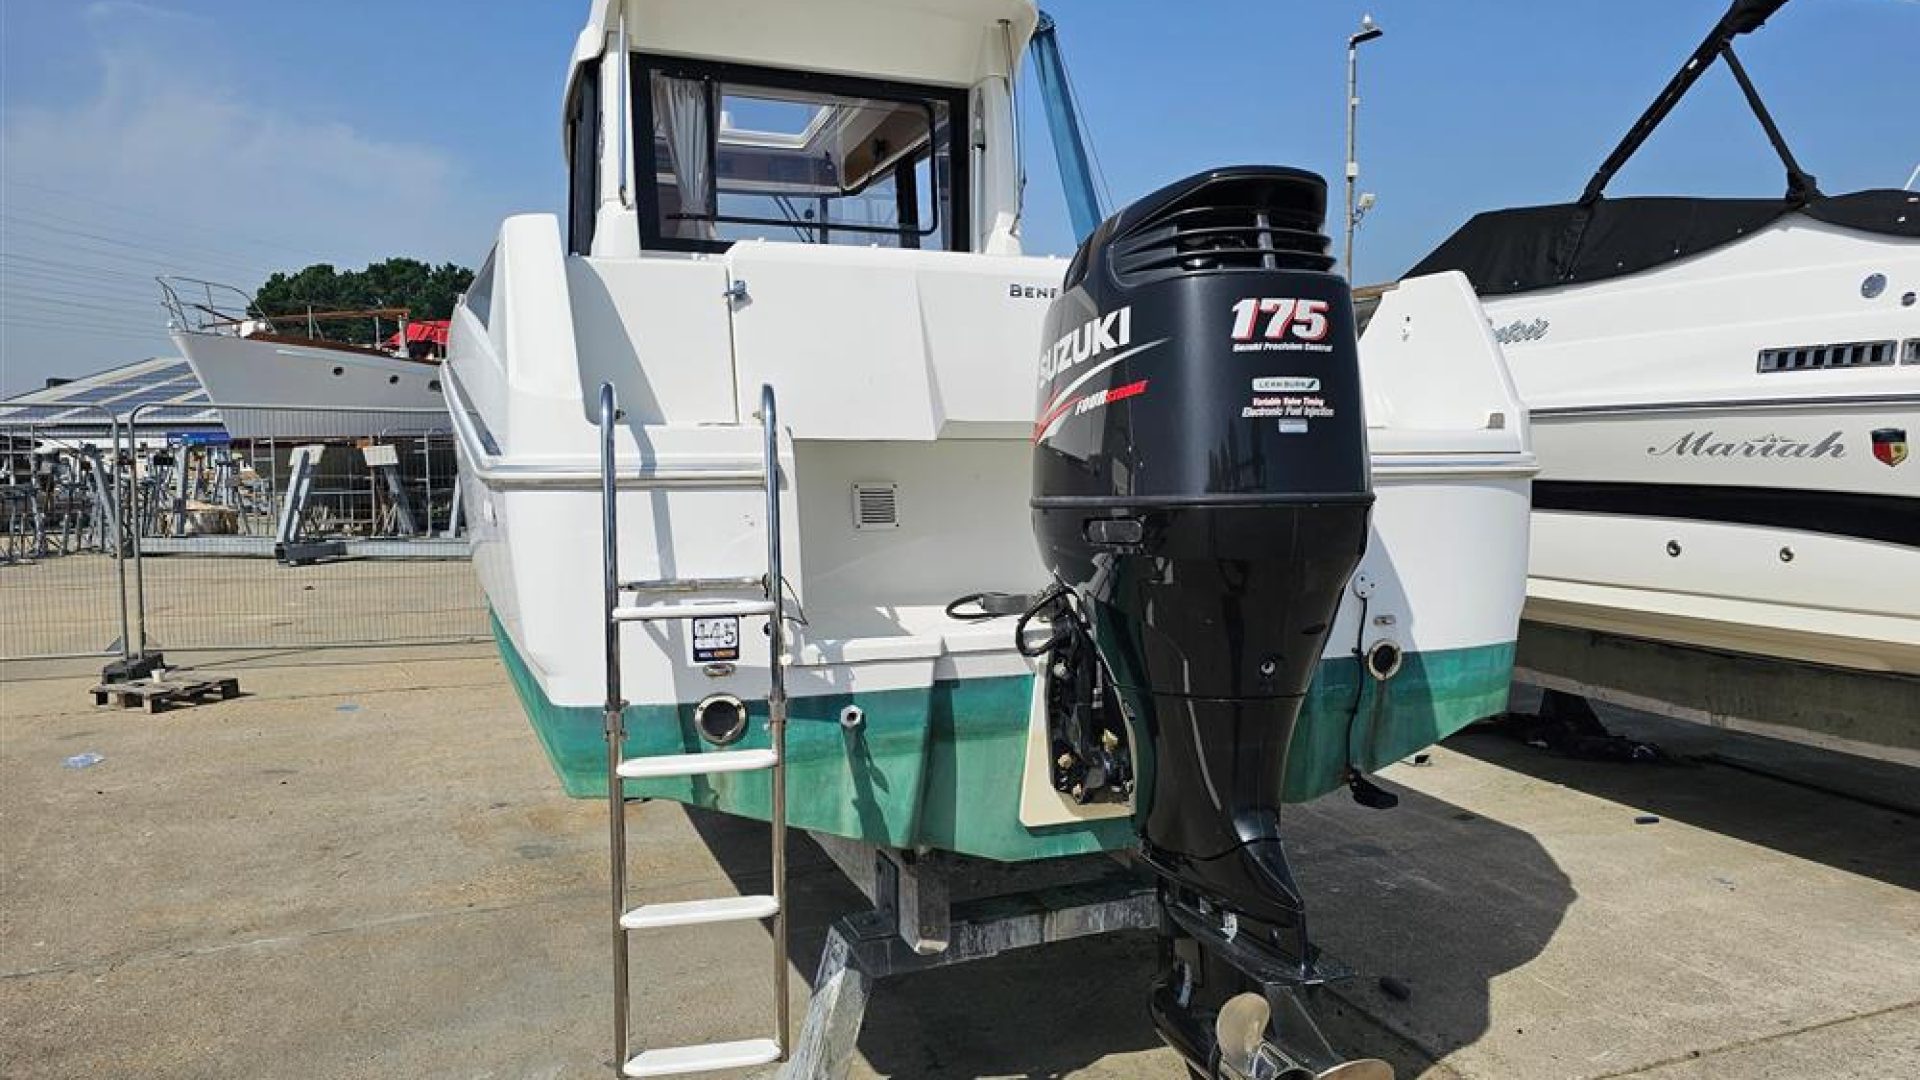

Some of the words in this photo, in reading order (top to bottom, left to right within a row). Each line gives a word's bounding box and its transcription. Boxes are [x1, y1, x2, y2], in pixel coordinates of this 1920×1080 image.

[1230, 298, 1329, 341] 175
[1039, 305, 1131, 389] SUZUKI
[1647, 430, 1846, 459] Mariah
